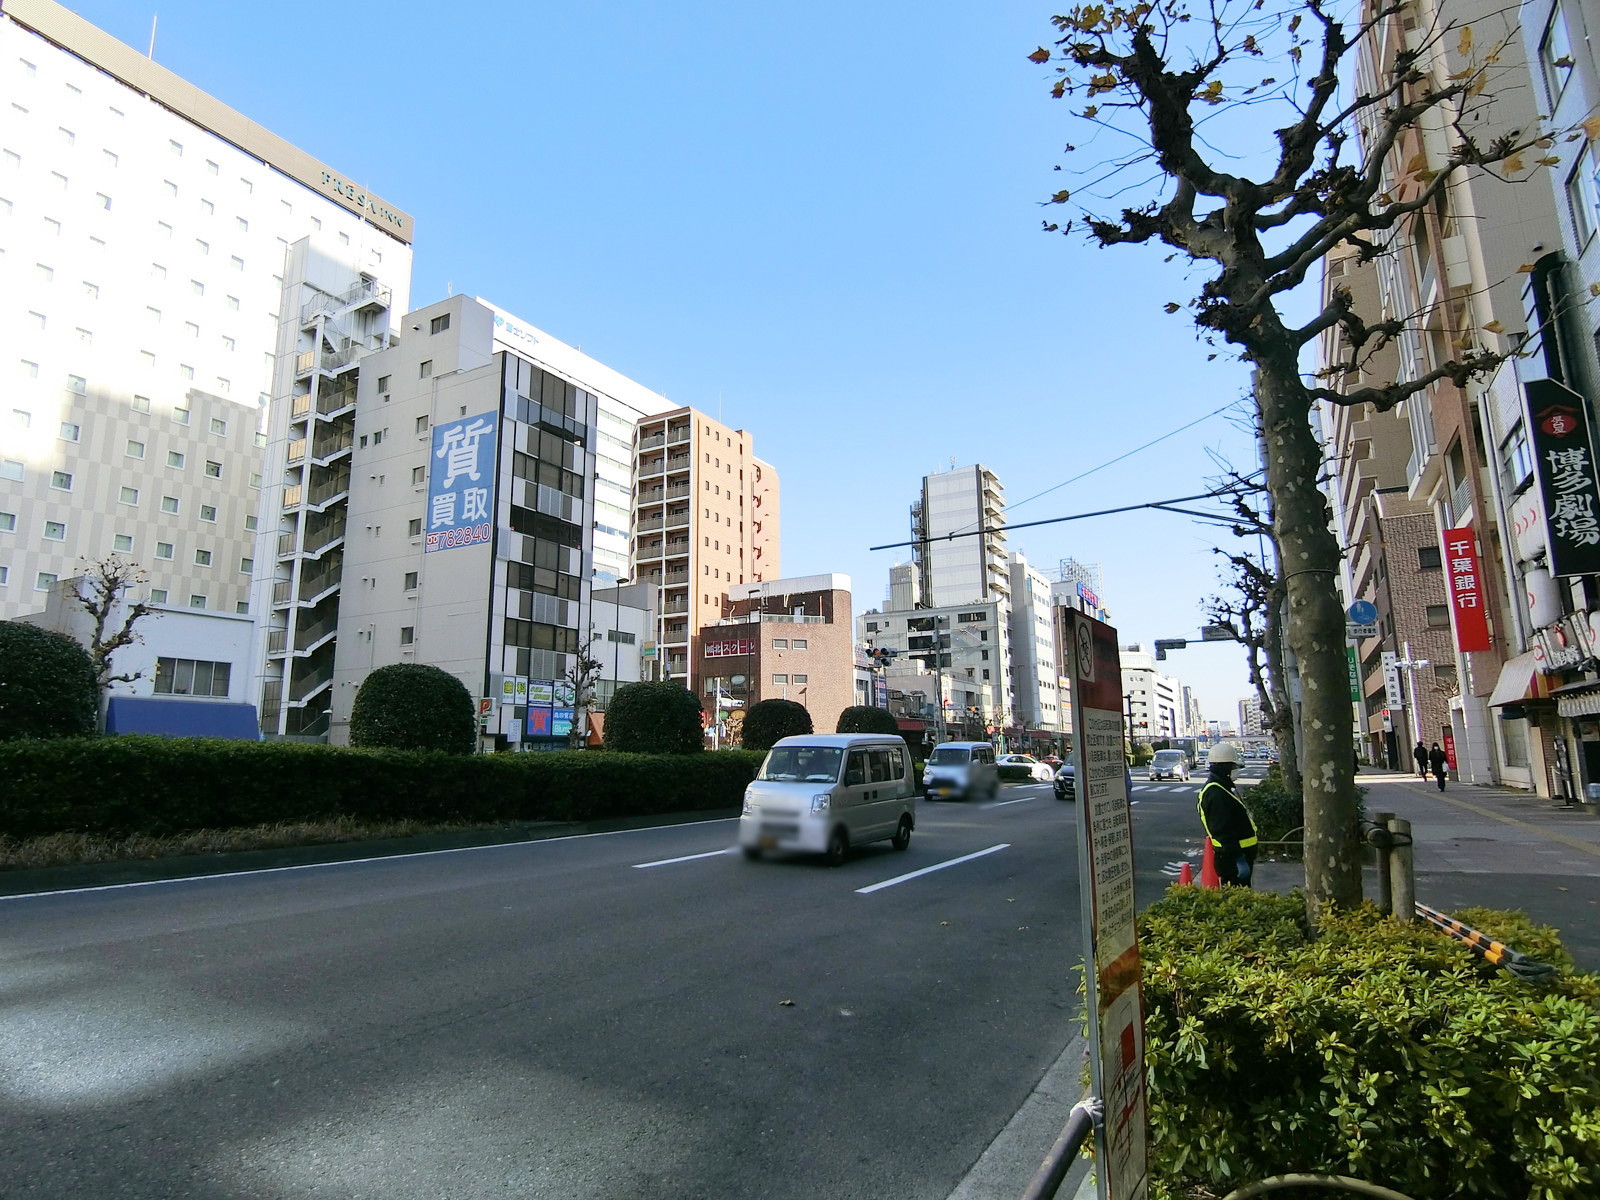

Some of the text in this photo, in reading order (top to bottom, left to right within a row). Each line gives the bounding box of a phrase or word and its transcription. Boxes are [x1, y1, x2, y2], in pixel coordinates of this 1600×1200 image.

[380, 207, 404, 229] INN
[436, 418, 493, 489] 質
[430, 487, 488, 530] 買取
[1545, 447, 1600, 548] 博多劇場
[440, 523, 490, 549] 782840
[1449, 540, 1477, 609] 千葉銀行
